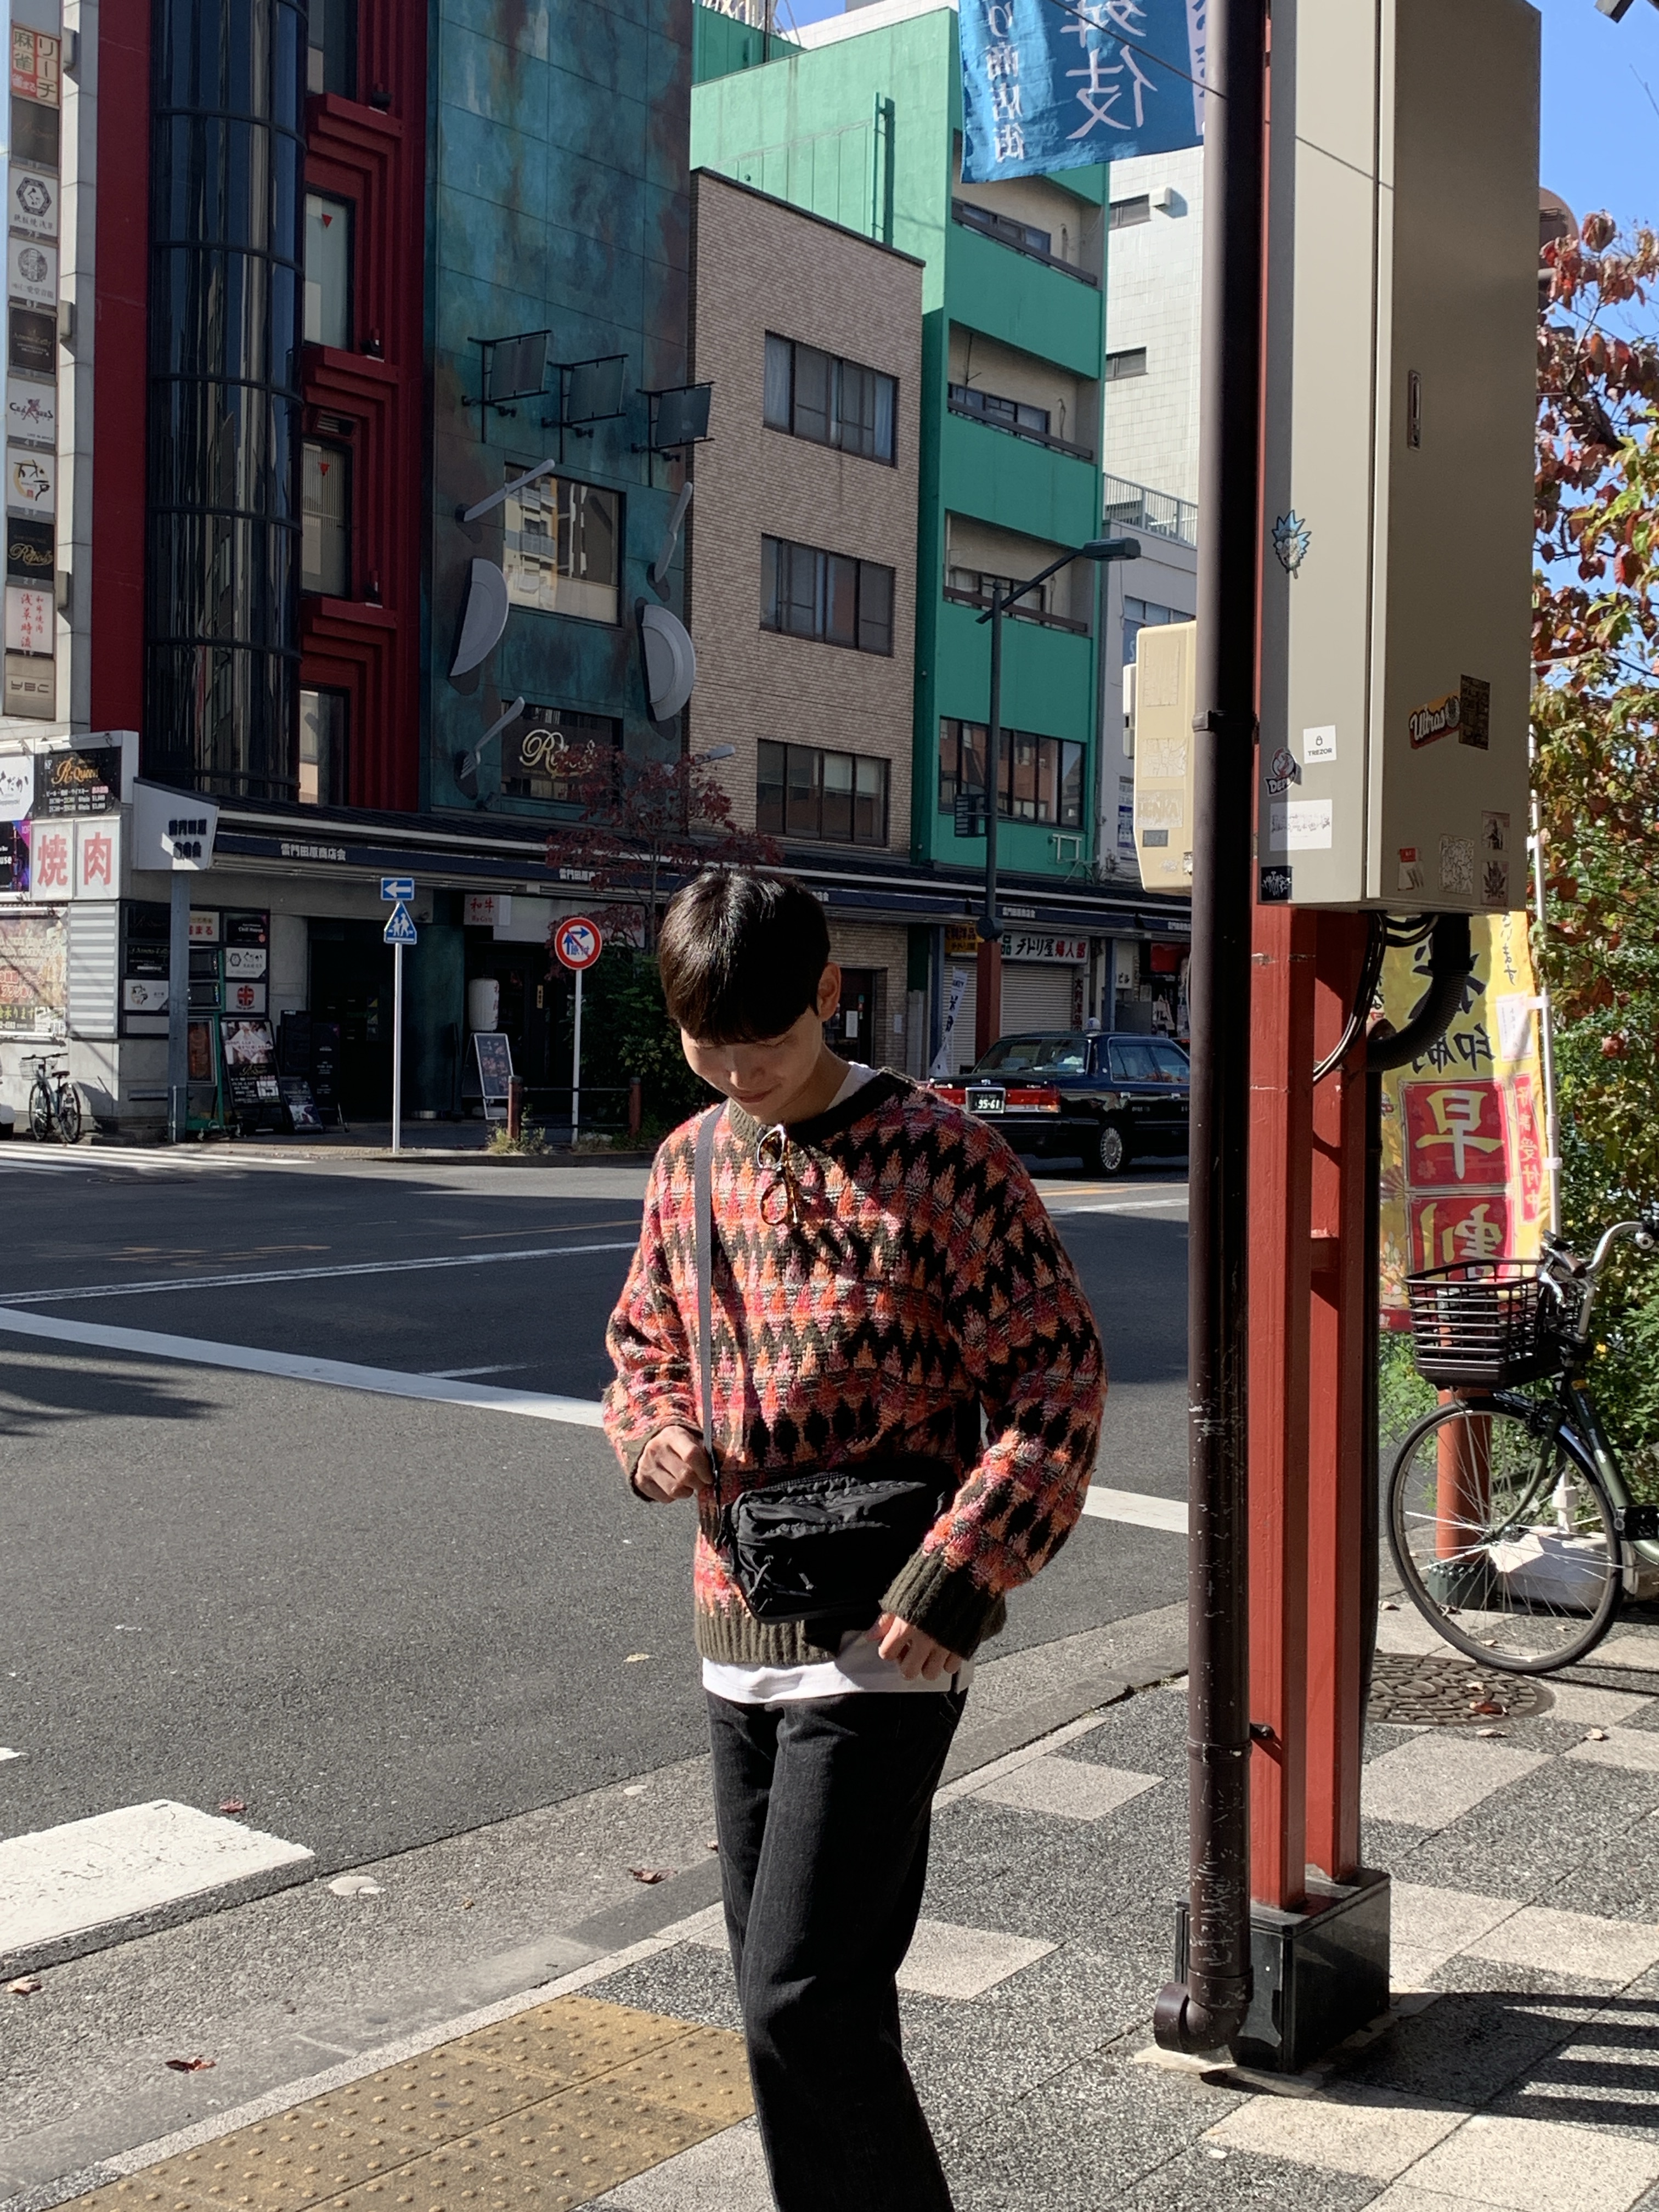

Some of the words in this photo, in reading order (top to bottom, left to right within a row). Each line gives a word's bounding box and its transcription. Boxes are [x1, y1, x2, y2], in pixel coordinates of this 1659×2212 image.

[14, 30, 33, 73] 麻雀
[38, 38, 57, 98] リーチ
[1410, 703, 1446, 741] Ultras
[1307, 747, 1333, 757] TREZOR
[37, 832, 112, 887] 焼肉
[470, 896, 494, 914] 和牛
[571, 945, 590, 956] 原付
[978, 1099, 1000, 1109] 95-61
